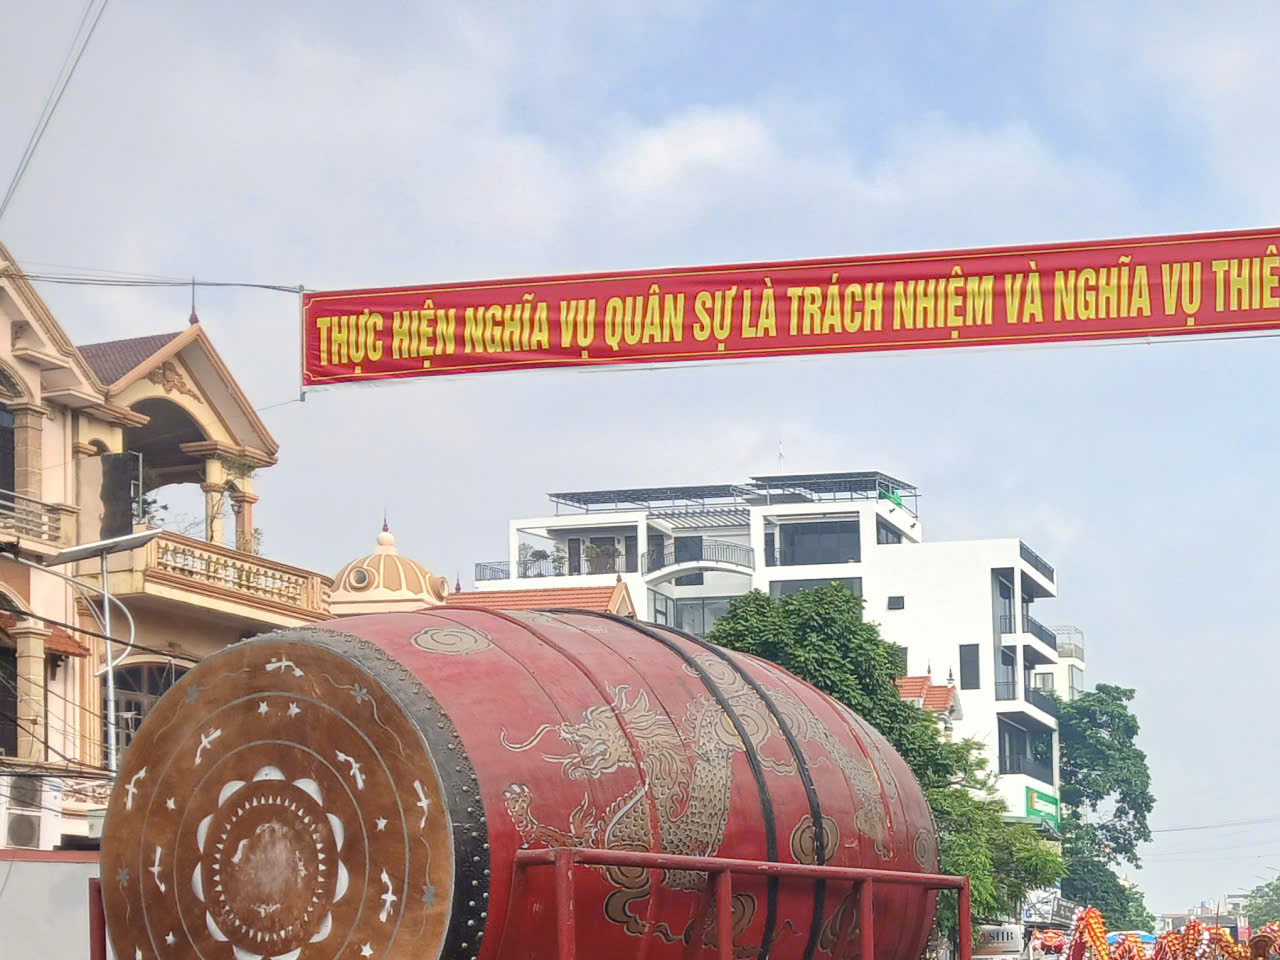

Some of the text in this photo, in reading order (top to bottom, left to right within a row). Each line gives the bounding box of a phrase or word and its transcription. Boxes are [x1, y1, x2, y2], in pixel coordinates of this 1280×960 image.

[316, 308, 384, 372] THỰC
[391, 300, 457, 368] HIỆN
[463, 294, 550, 353] NGHĨA
[559, 298, 597, 359] VỤ
[604, 284, 685, 352] QUÂN
[692, 285, 738, 351] SỰ
[741, 277, 777, 339] LÀ
[786, 272, 885, 336] TRÁCH
[892, 265, 995, 339] NHIỆM
[1004, 260, 1044, 324] VÀ
[1053, 255, 1152, 322] NGHĨA
[1161, 261, 1202, 327] VỤ
